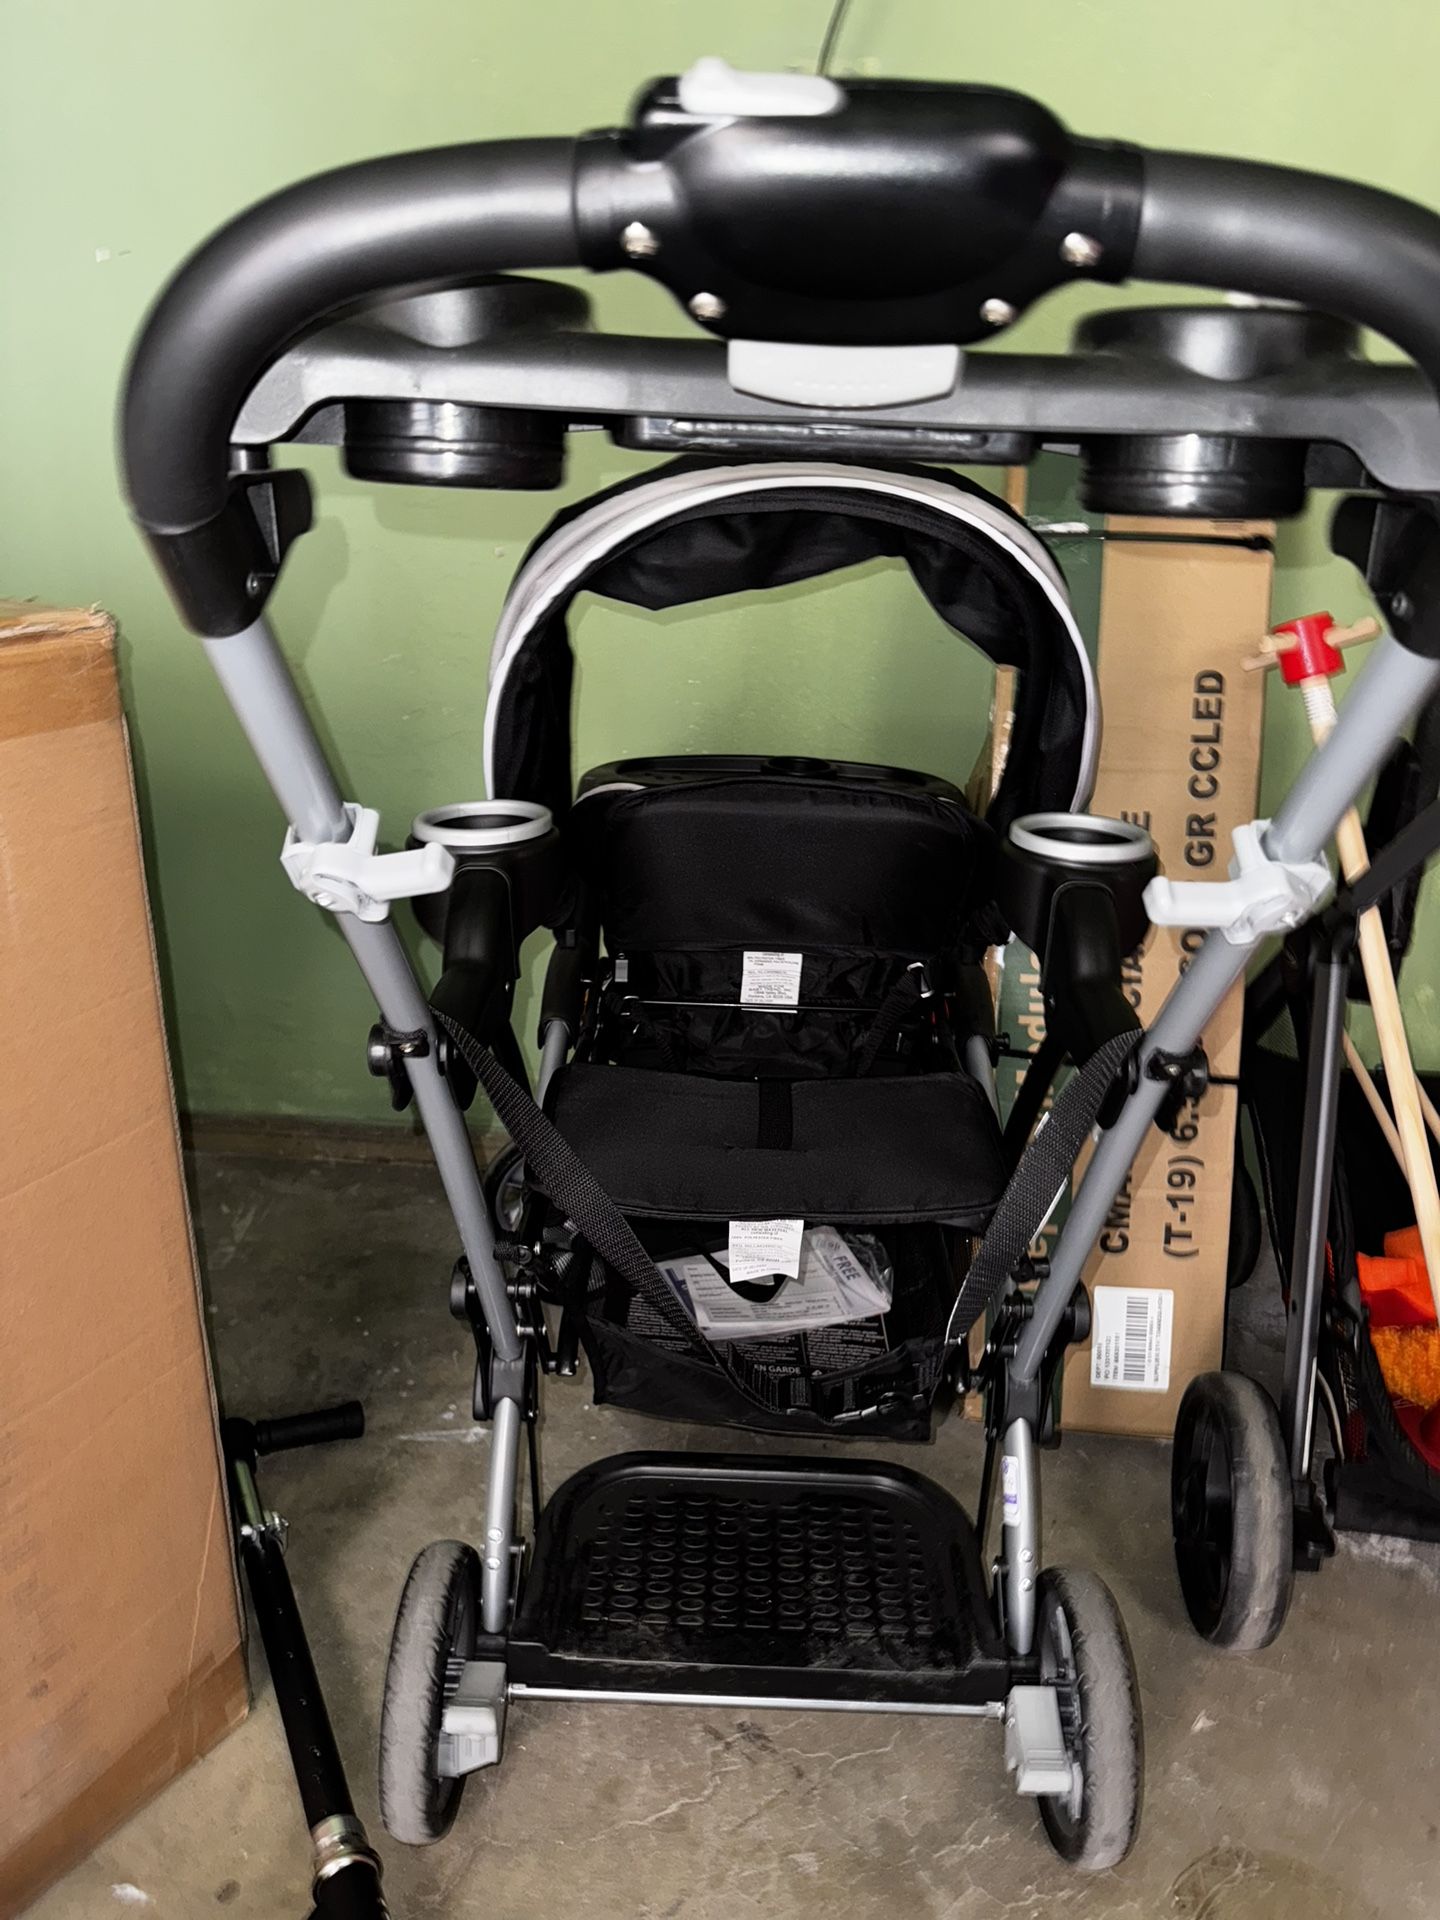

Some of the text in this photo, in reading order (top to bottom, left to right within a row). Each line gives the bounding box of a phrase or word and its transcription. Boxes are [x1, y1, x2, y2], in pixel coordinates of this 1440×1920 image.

[1188, 669, 1226, 800] CCLED
[1185, 812, 1216, 867] GR
[1163, 1155, 1205, 1258] (T-19)
[833, 1255, 861, 1281] FREE
[768, 1365, 800, 1375] GARDE
